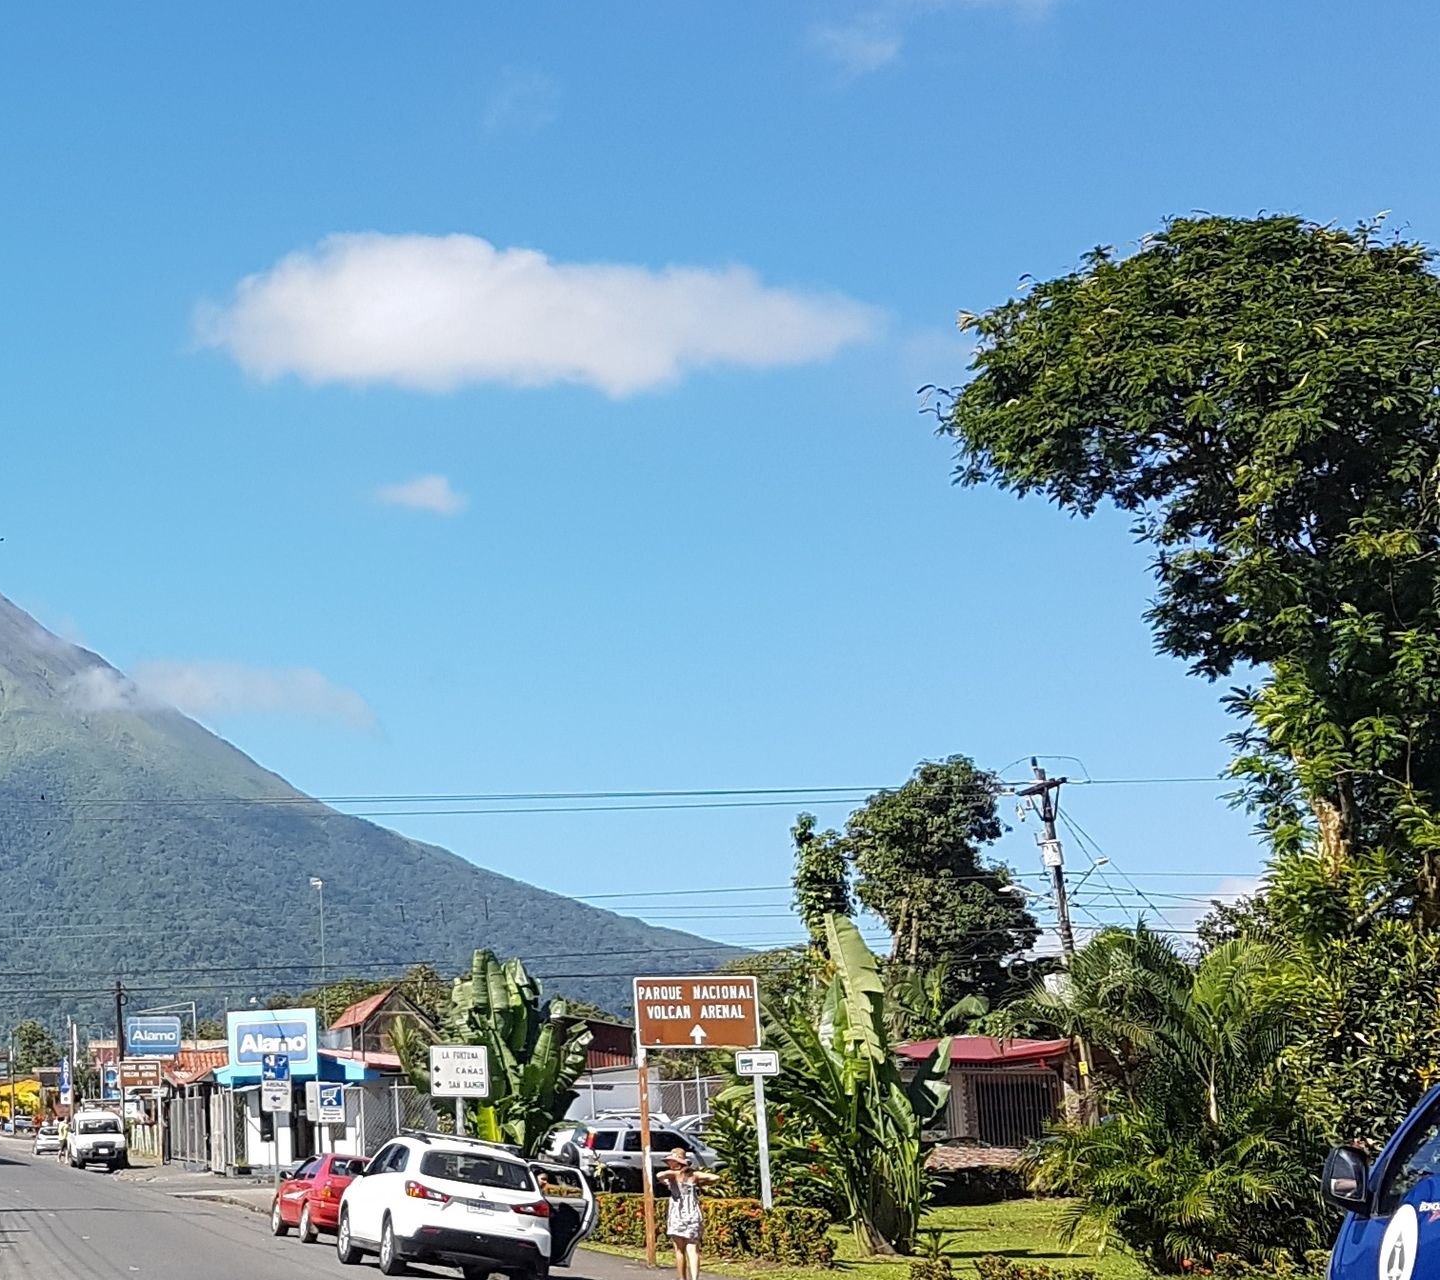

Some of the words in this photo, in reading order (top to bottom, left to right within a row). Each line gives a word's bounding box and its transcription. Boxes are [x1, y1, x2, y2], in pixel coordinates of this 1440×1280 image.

[638, 985, 683, 1000] PARQUE
[692, 984, 753, 1000] NACIONAL
[646, 1004, 691, 1020] VOLCAN
[700, 1004, 745, 1019] ARENAL
[132, 1030, 176, 1041] Alamo
[240, 1033, 306, 1054] Alamo
